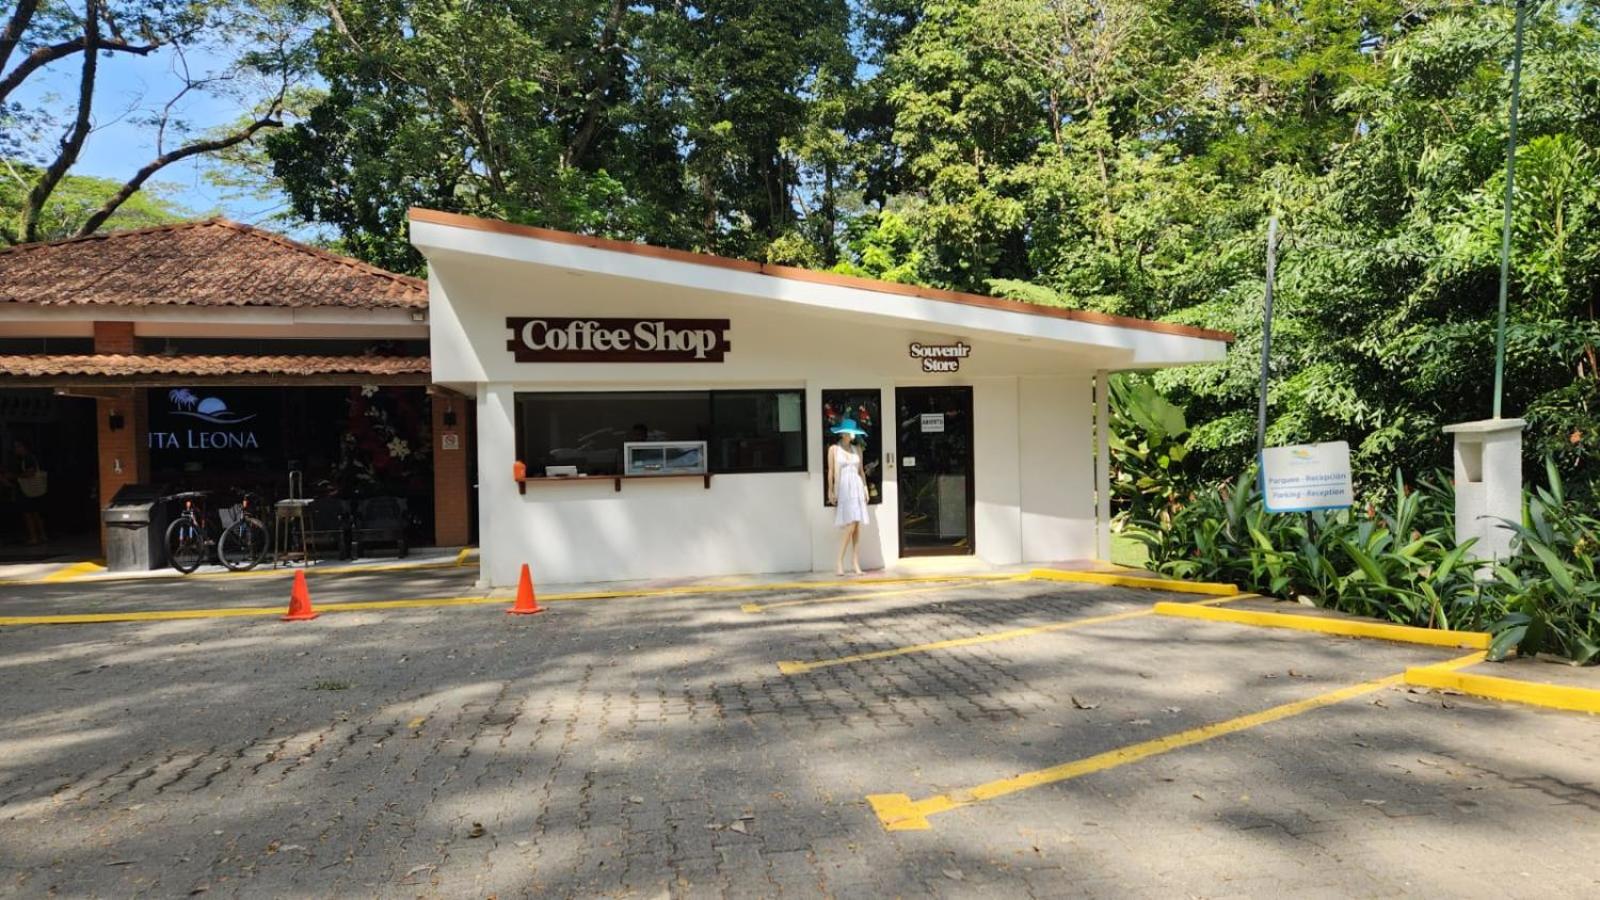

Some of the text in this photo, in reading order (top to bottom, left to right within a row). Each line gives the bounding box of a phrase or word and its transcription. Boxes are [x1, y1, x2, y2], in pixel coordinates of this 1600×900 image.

[521, 319, 717, 359] Coffee Shop
[910, 342, 970, 357] Souvenir
[923, 357, 958, 371] Store
[1272, 489, 1301, 498] Parking
[1306, 487, 1345, 497] Reception
